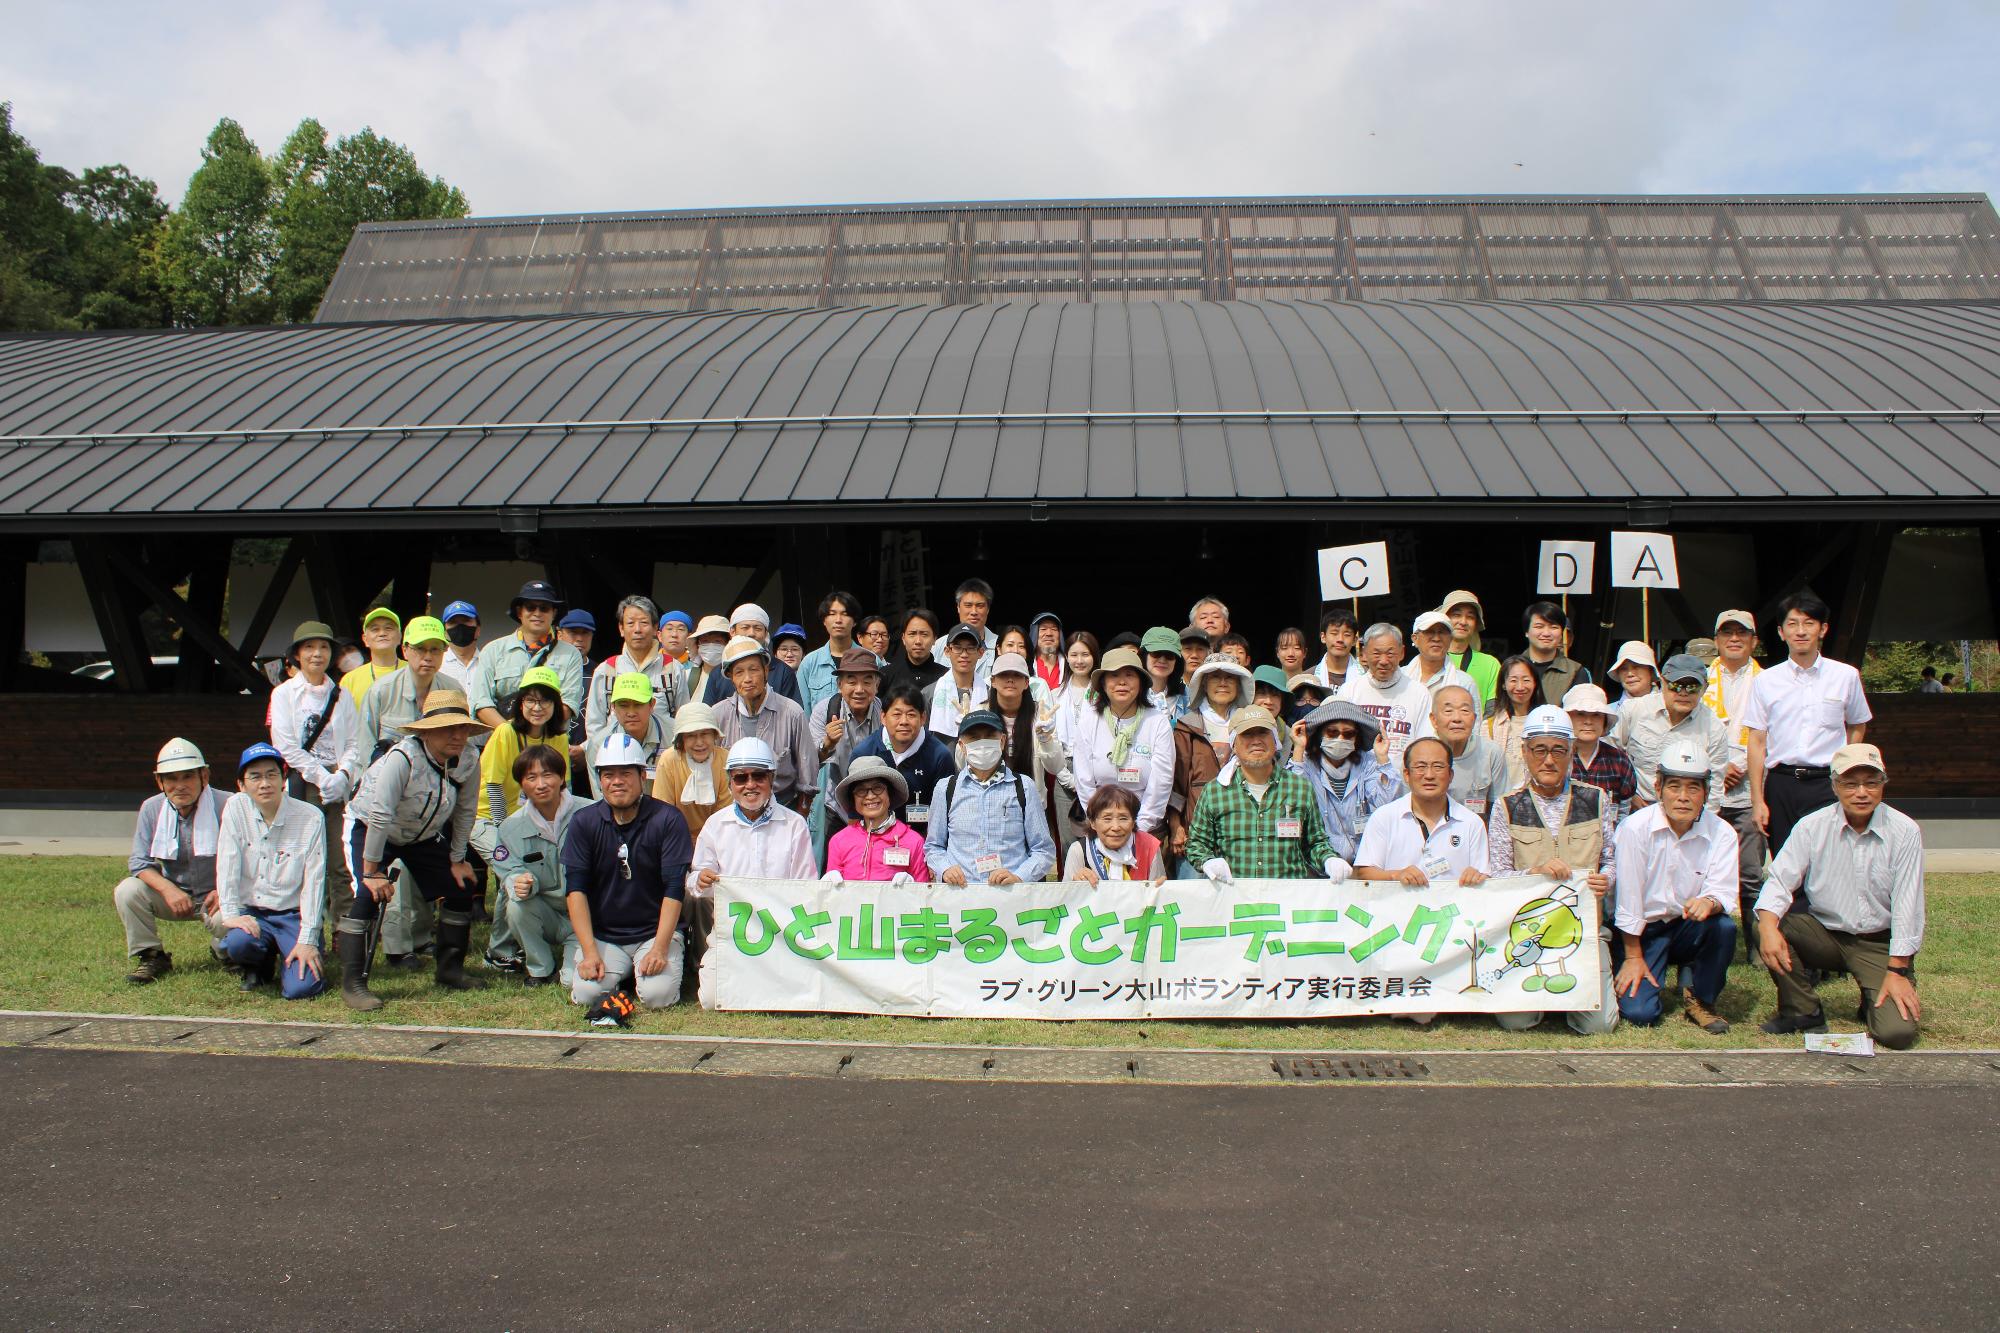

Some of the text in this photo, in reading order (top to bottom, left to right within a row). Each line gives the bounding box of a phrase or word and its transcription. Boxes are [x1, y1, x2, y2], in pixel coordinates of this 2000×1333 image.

[1339, 556, 1370, 591] C
[1553, 552, 1578, 588] D
[1632, 544, 1664, 581] A
[730, 902, 1457, 965] ひと山まるごとガーデニング
[979, 975, 1433, 1003] ラブ・グリーン大山ボランティア実行委員会
